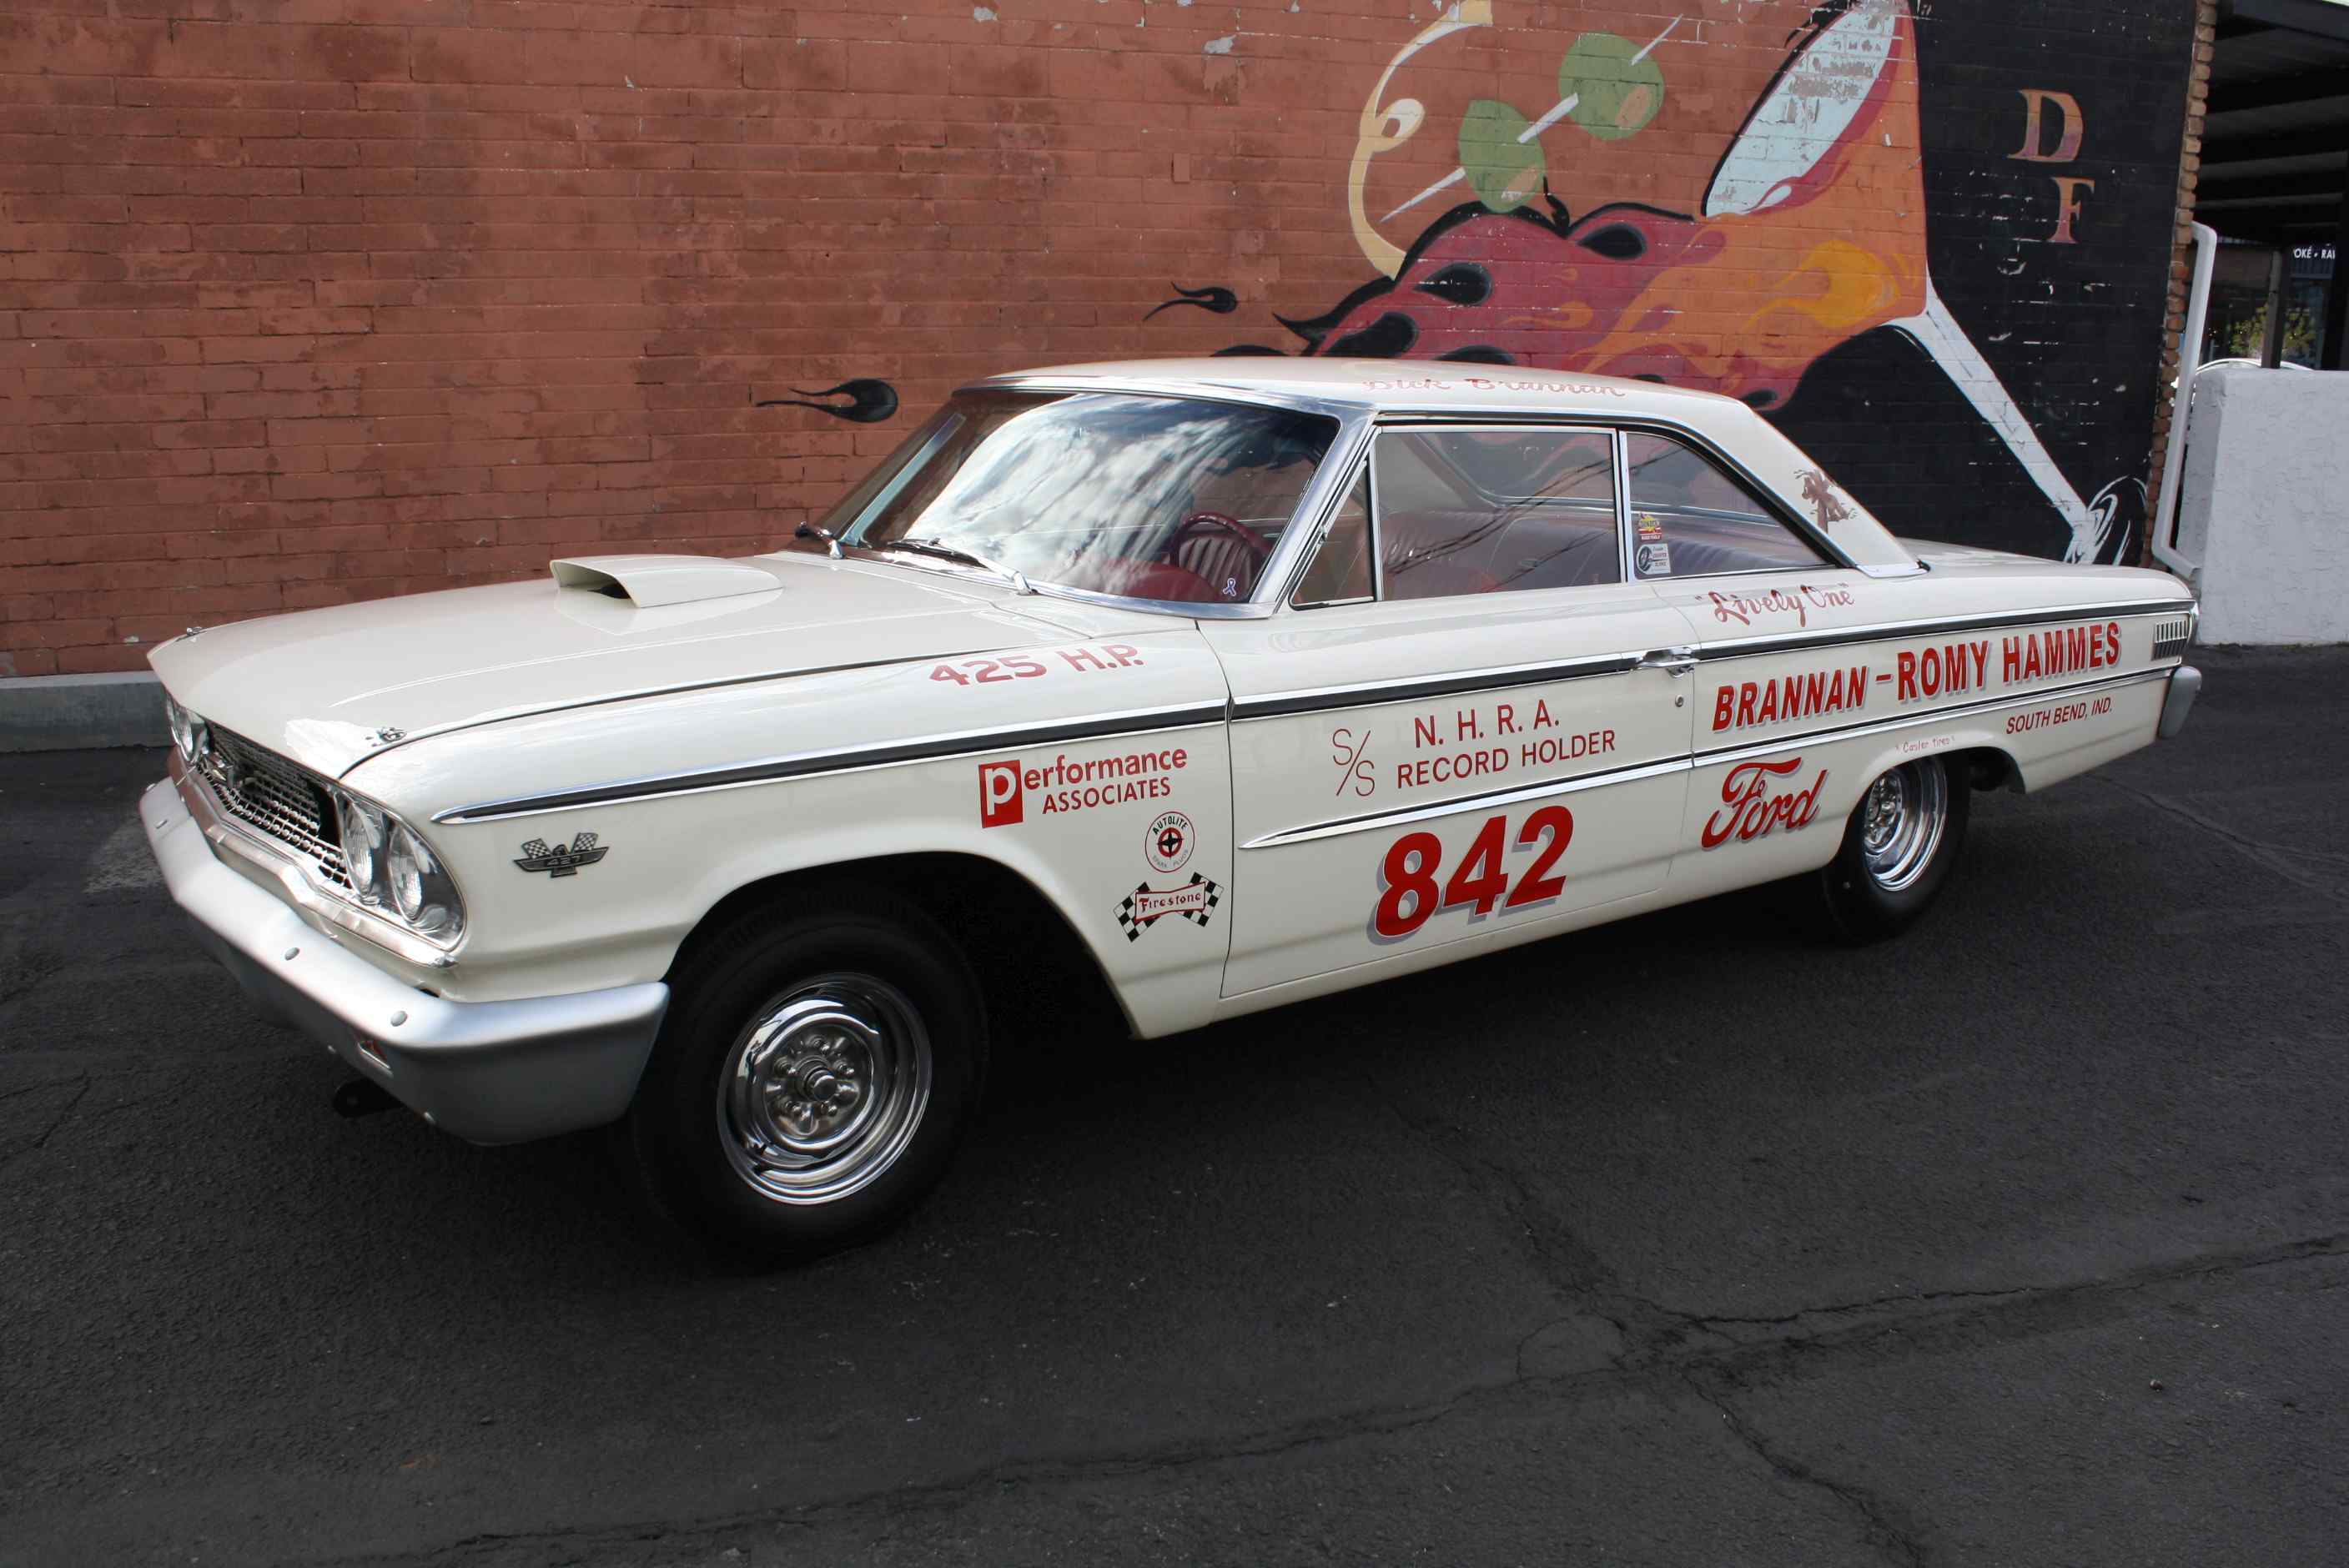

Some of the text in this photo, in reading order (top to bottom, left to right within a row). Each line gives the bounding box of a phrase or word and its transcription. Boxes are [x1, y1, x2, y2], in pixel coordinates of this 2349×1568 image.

[2006, 88, 2084, 163] D
[2046, 176, 2095, 244] F
[2293, 245, 2313, 259] OKÉ
[928, 644, 1144, 686] 425 H.P.
[1713, 665, 1869, 732] BRANNAN
[2003, 621, 2123, 685] HAMMES
[2006, 710, 2051, 735] SOUTH
[2090, 696, 2113, 715] IND.
[1397, 730, 1616, 789] RECORD HOLDER
[1042, 776, 1171, 814] ASSOCIATES
[1702, 756, 1830, 851] Ford
[1153, 816, 1189, 836] AUTOLITE
[546, 855, 581, 867] 427
[1367, 805, 1575, 945] 842
[1138, 892, 1202, 912] Firestone
